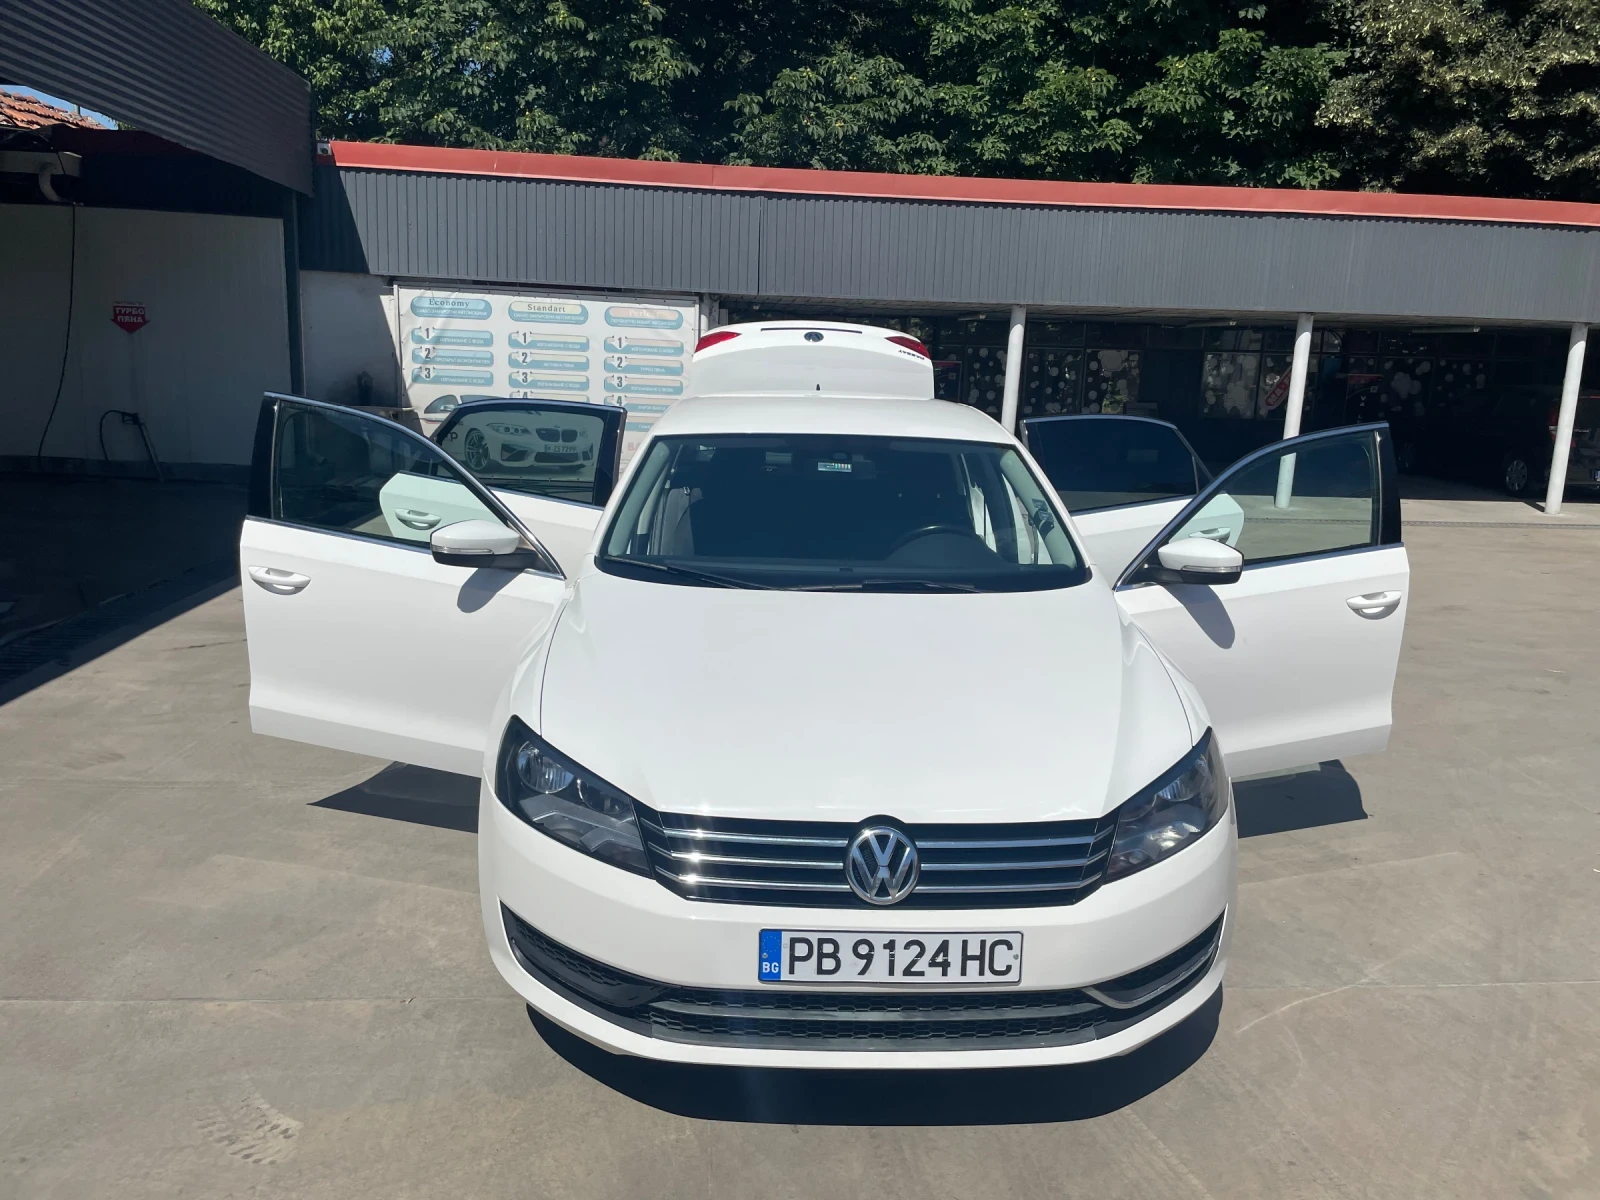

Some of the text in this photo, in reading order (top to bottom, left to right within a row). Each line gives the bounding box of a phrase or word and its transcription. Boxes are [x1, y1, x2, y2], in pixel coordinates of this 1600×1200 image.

[429, 298, 470, 308] Economy
[527, 303, 566, 313] Standart
[425, 327, 430, 339] 1
[522, 332, 527, 344] 1
[617, 337, 622, 349] 1
[425, 348, 431, 359] 2
[522, 352, 528, 364] 2
[617, 357, 623, 368] 2
[425, 367, 431, 379] 3
[522, 372, 528, 383] 3
[617, 376, 623, 388] 3
[852, 938, 951, 977] 9124
[762, 961, 779, 974] BG
